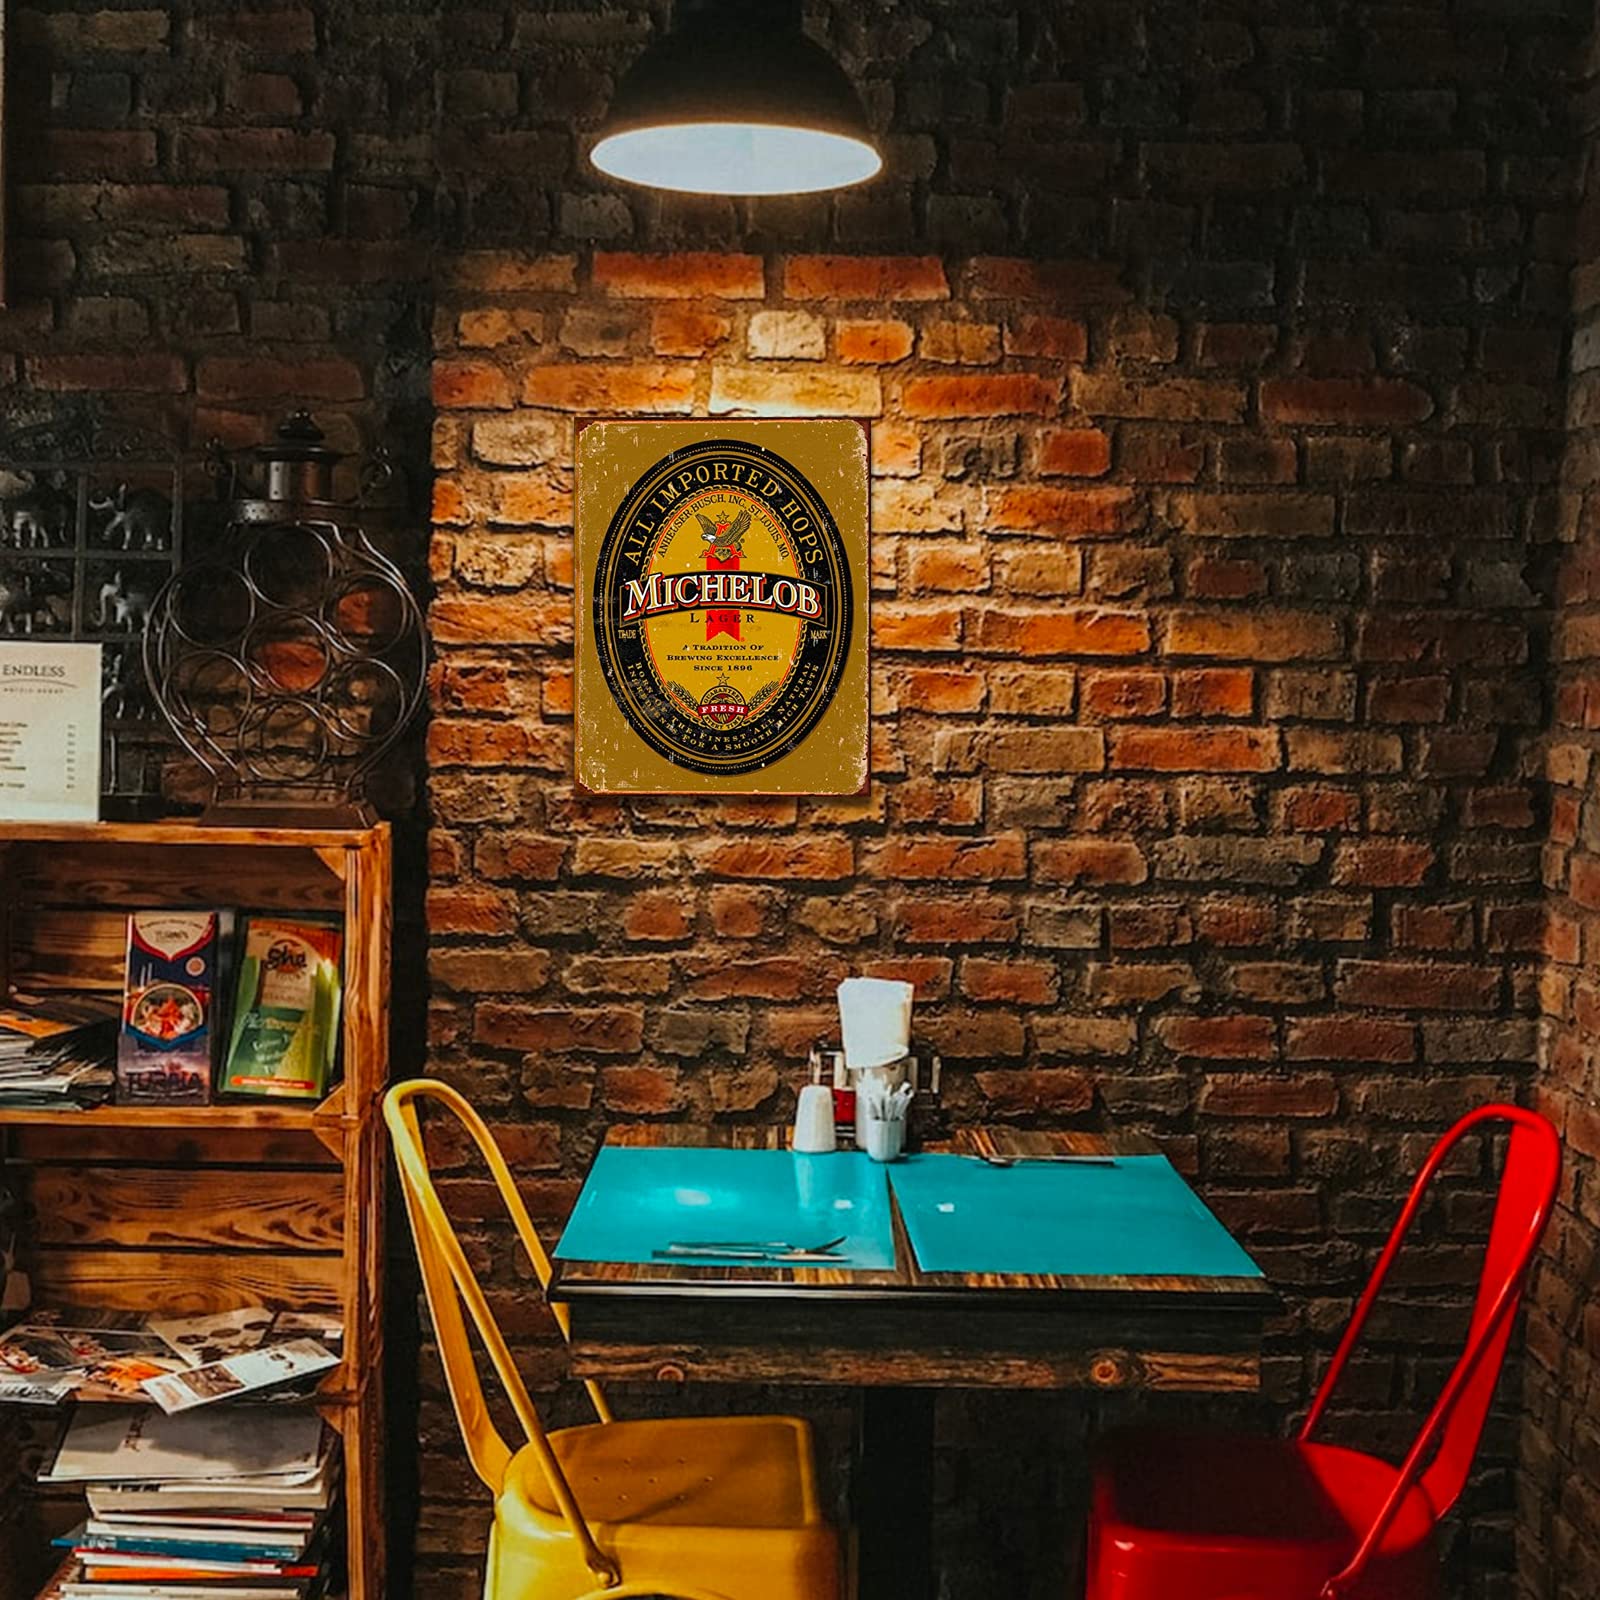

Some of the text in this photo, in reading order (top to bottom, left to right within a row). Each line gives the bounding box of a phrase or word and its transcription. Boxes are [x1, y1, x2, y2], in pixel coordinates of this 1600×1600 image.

[624, 463, 823, 566] ALL IMPORTED HOPS
[623, 573, 820, 619] MICHELOB
[690, 614, 755, 623] LAGER
[618, 630, 637, 639] TRADE
[3, 664, 66, 677] ENDLESS
[682, 734, 705, 748] FOR
[725, 730, 773, 751] SMOOTH
[798, 664, 819, 699] TASTE
[700, 733, 747, 743] FINEST
[754, 718, 775, 734] ALL
[778, 662, 811, 715] NATURAL
[701, 705, 744, 713] FRESH
